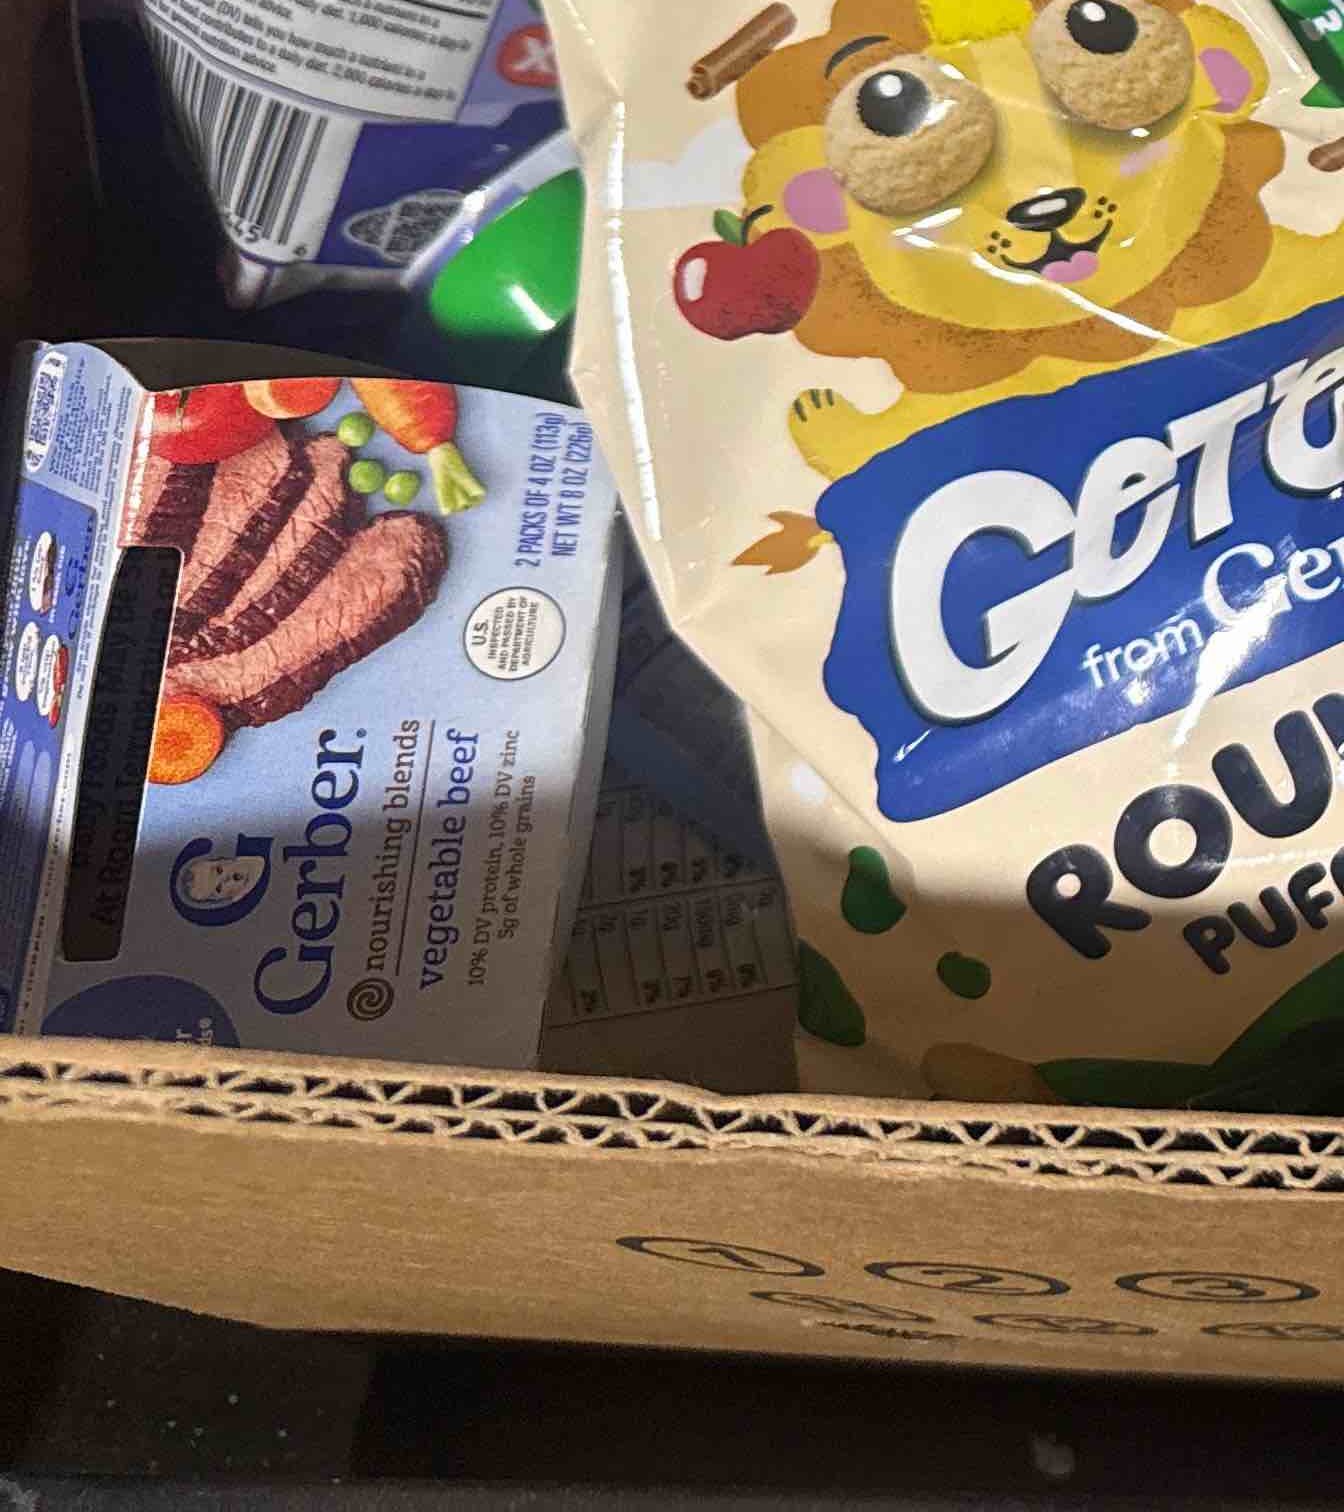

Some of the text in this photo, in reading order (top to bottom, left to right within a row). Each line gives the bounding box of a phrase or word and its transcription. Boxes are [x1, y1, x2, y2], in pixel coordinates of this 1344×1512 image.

[531, 453, 557, 474] OZ
[562, 466, 590, 485] OZ
[523, 485, 551, 511] OF
[528, 476, 552, 487] 4
[557, 499, 585, 525] WT
[518, 510, 549, 556] PACKS
[552, 524, 580, 558] NET
[514, 557, 542, 570] 2
[471, 618, 490, 647] U.S.
[1081, 613, 1206, 694] from
[503, 729, 522, 768] zinc
[495, 771, 514, 802] DV
[516, 774, 536, 835] grains
[487, 803, 507, 845] 10%
[364, 718, 421, 972] nourishing blends
[419, 727, 479, 990] vegetable beef
[505, 835, 528, 889] whole
[472, 916, 491, 947] DV
[468, 946, 487, 988] 10%
